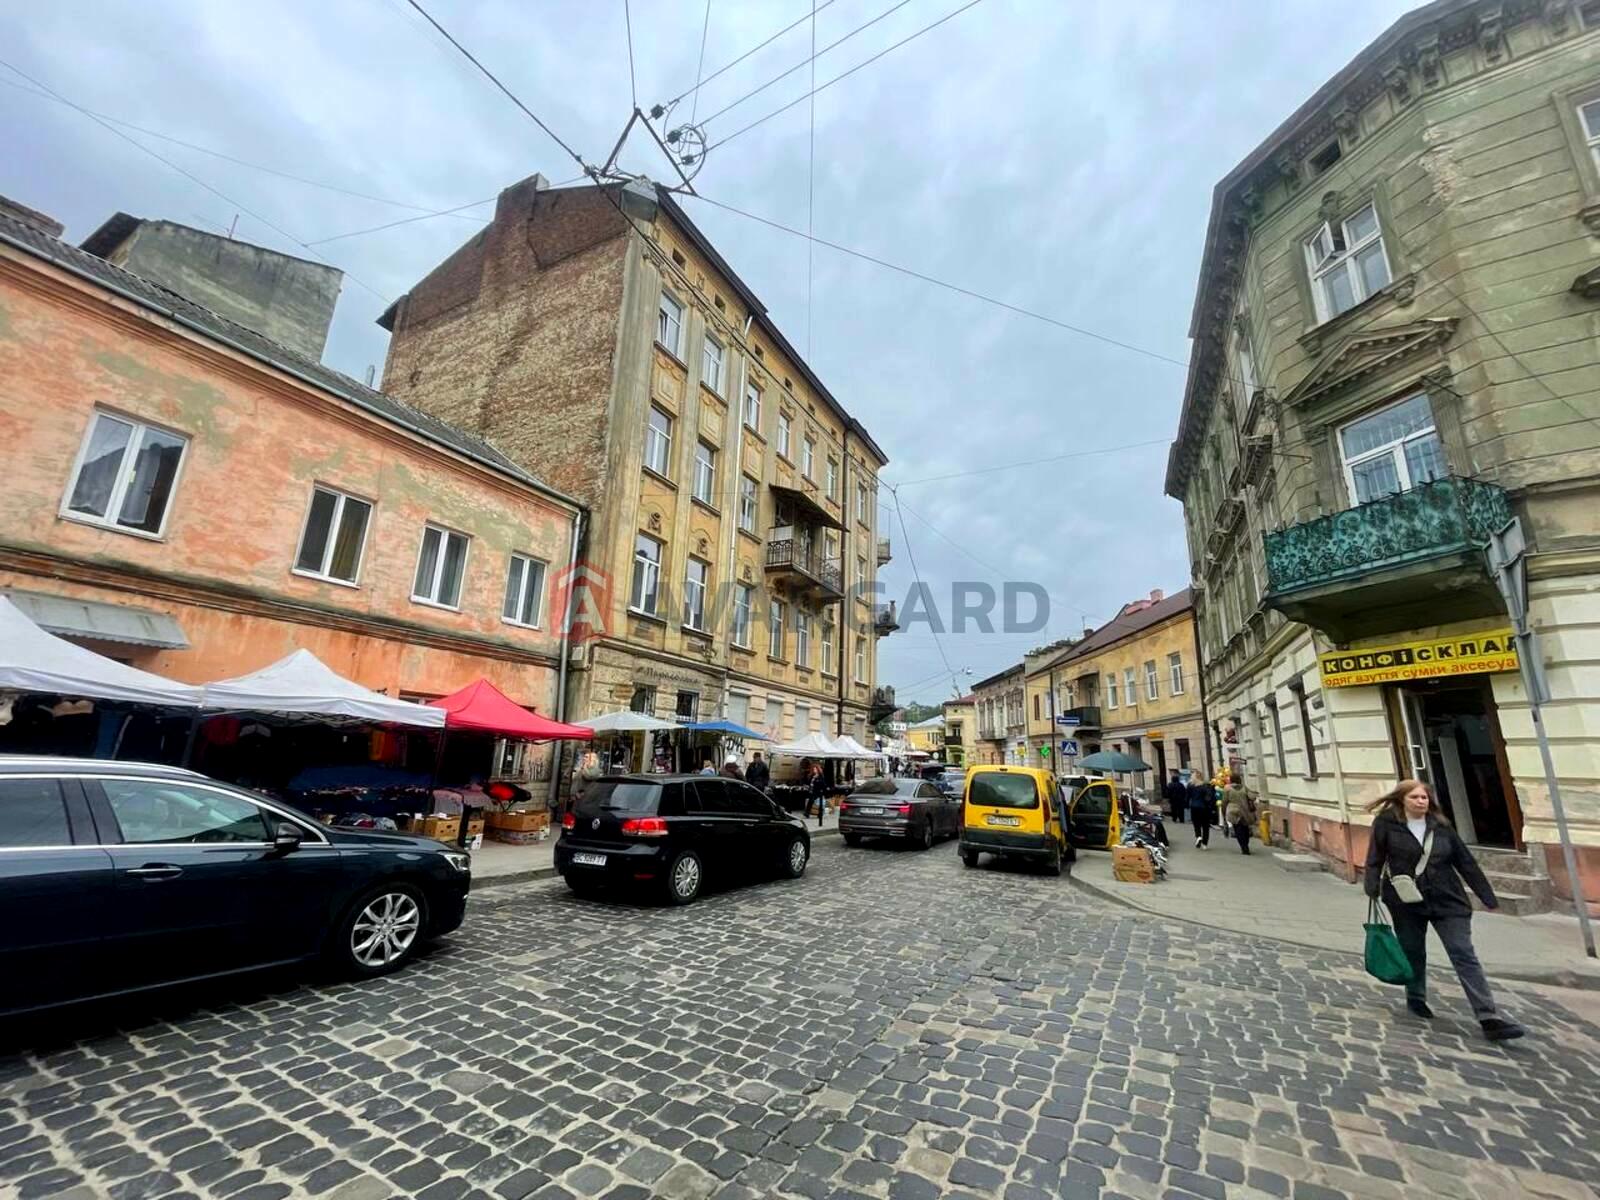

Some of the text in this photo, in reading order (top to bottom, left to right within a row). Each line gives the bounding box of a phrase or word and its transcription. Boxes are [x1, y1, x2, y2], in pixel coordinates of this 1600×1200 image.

[1356, 671, 1399, 684] взуття
[1402, 666, 1446, 679] сумки
[1452, 657, 1518, 673] аксесуа
